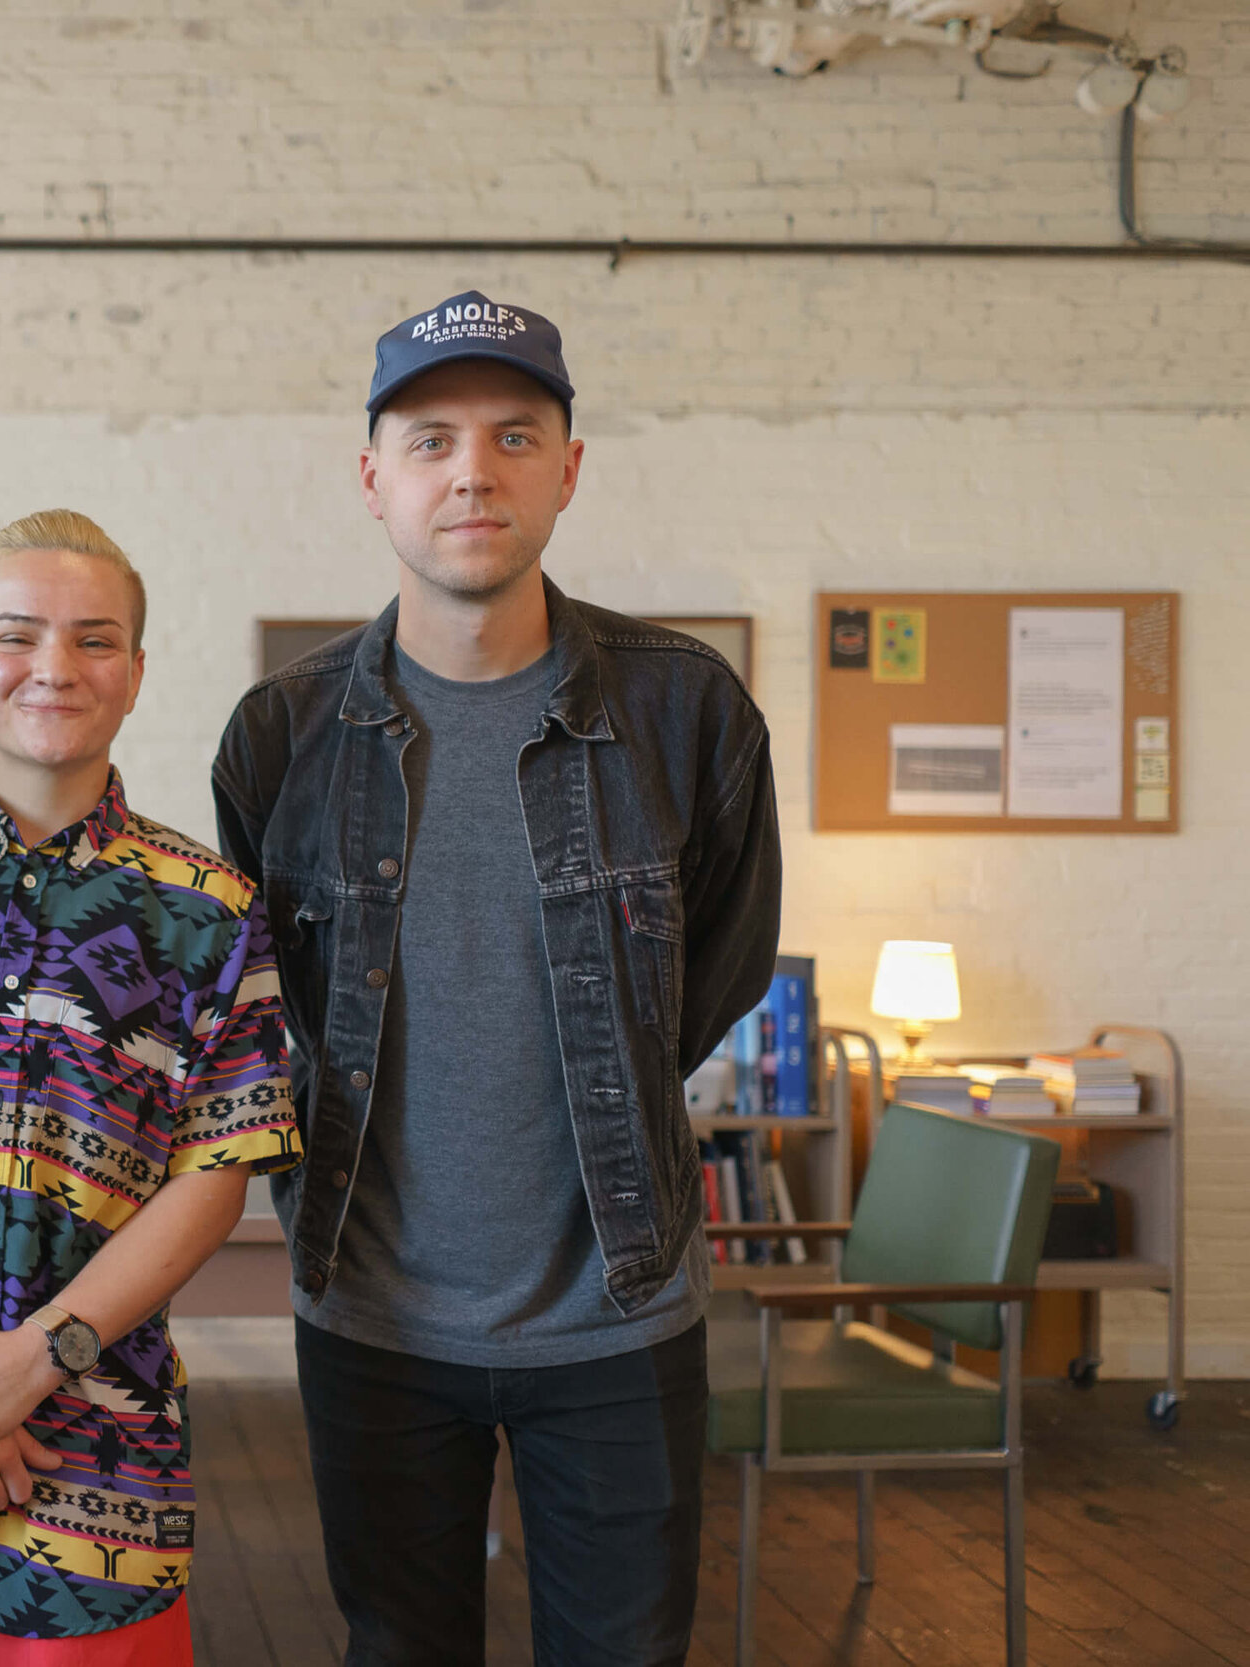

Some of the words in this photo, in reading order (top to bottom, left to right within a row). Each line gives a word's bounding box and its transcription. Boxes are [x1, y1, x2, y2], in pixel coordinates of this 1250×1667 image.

[411, 312, 439, 339] DE
[445, 302, 526, 332] NOLF'S
[424, 323, 516, 342] BARBERSHOP
[434, 333, 463, 344] SOUTH
